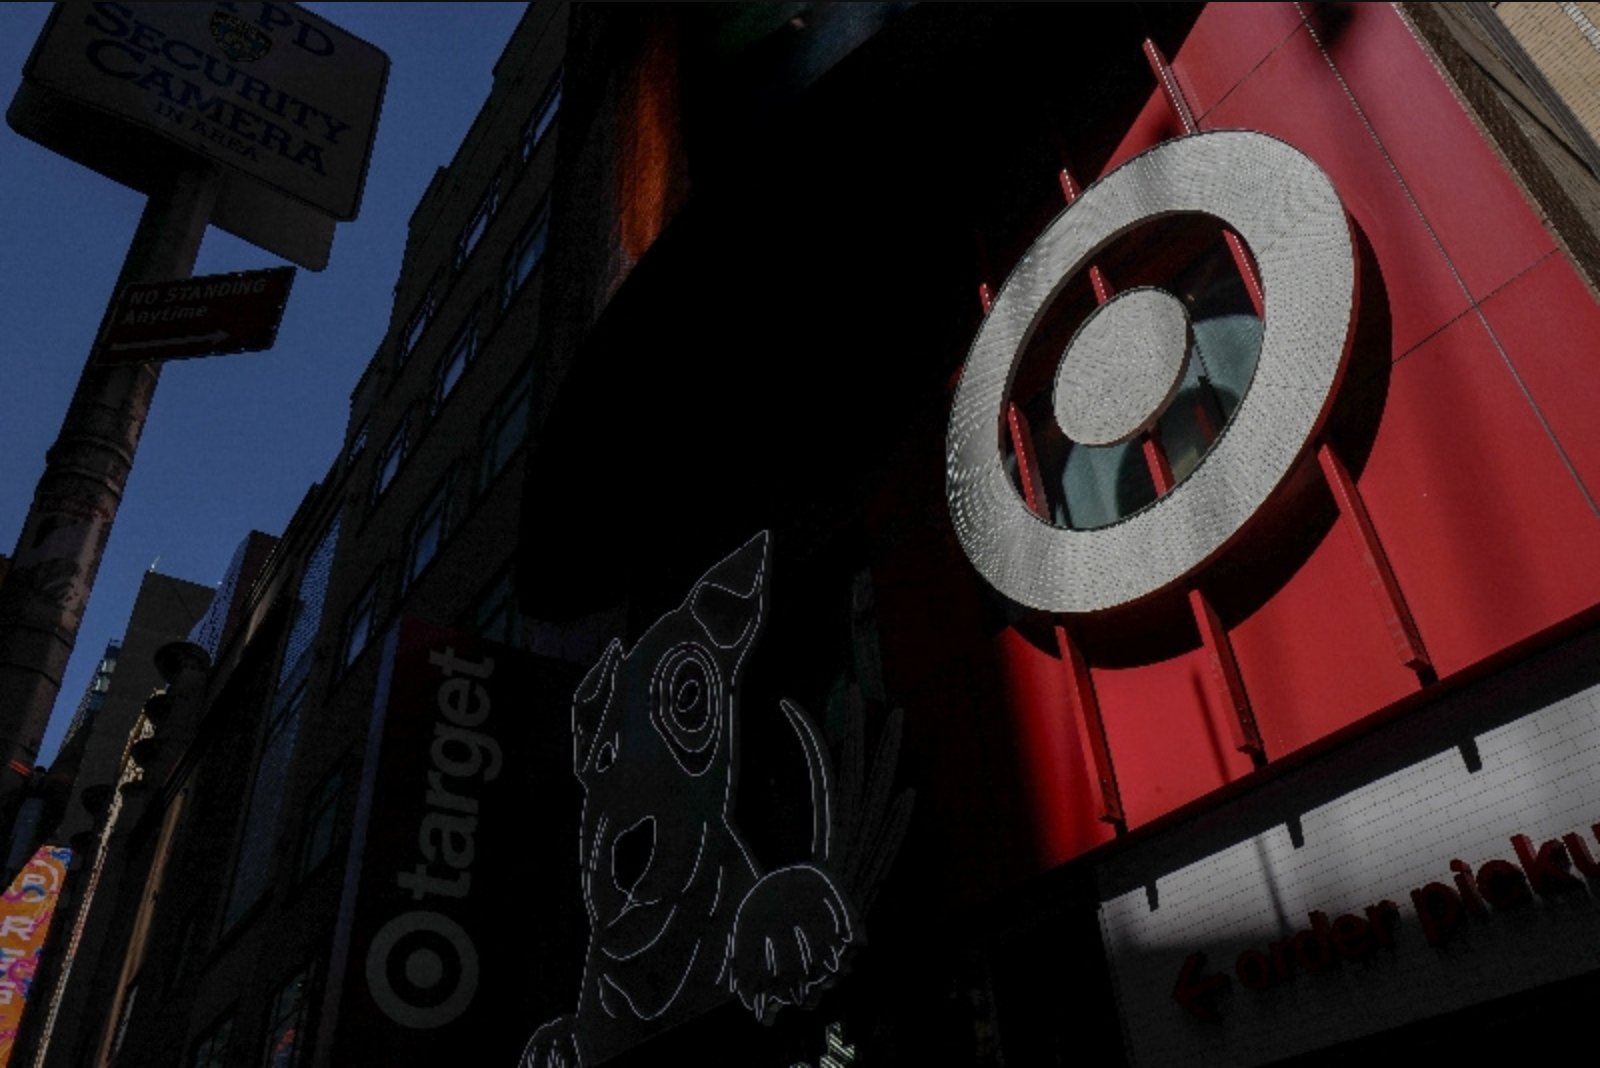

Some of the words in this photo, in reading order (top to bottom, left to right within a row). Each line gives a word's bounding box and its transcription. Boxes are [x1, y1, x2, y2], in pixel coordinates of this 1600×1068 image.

[85, 2, 350, 144] SECURITY
[86, 39, 326, 176] CAMERA
[154, 101, 186, 124] IN
[190, 117, 259, 162] AREA
[123, 304, 209, 327] Anytime
[128, 288, 162, 305] NO
[164, 278, 268, 303] STANDING
[397, 644, 503, 900] target
[1236, 899, 1398, 991] order
